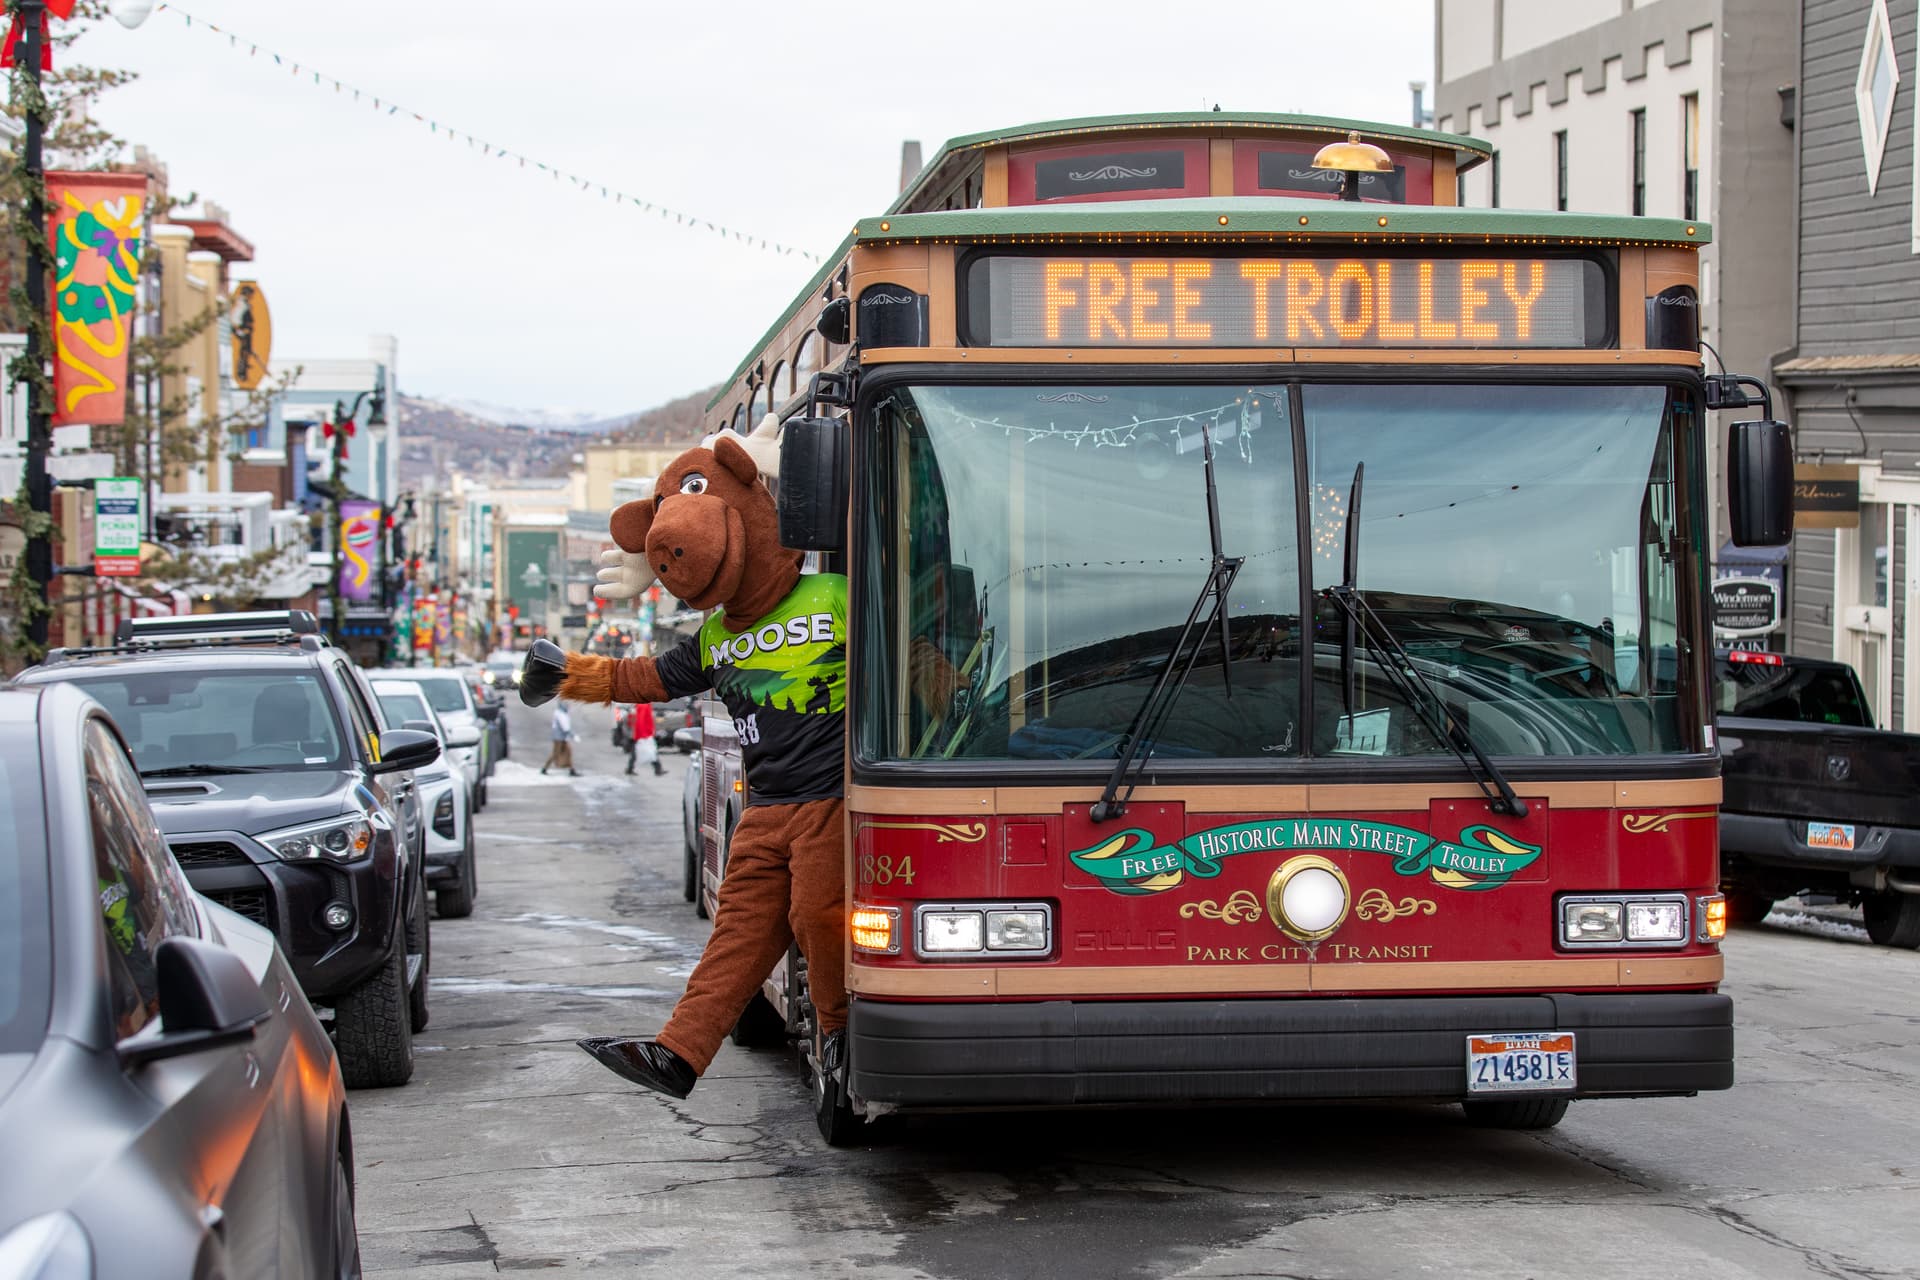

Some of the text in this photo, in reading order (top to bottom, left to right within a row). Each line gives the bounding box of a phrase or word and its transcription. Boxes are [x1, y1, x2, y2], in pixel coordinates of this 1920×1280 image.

[1045, 262, 1544, 339] FREE TROLLEY
[708, 612, 835, 670] MOOSE
[1199, 821, 1418, 859] HISTORIC MAIN STREET
[1121, 853, 1179, 876] FREE
[1441, 844, 1507, 873] TROLLEY
[1074, 929, 1177, 951] GILLIG
[1186, 943, 1433, 961] PARK CITY TRANSIT
[1504, 1040, 1541, 1049] UTAH
[1476, 1053, 1554, 1082] 214581
